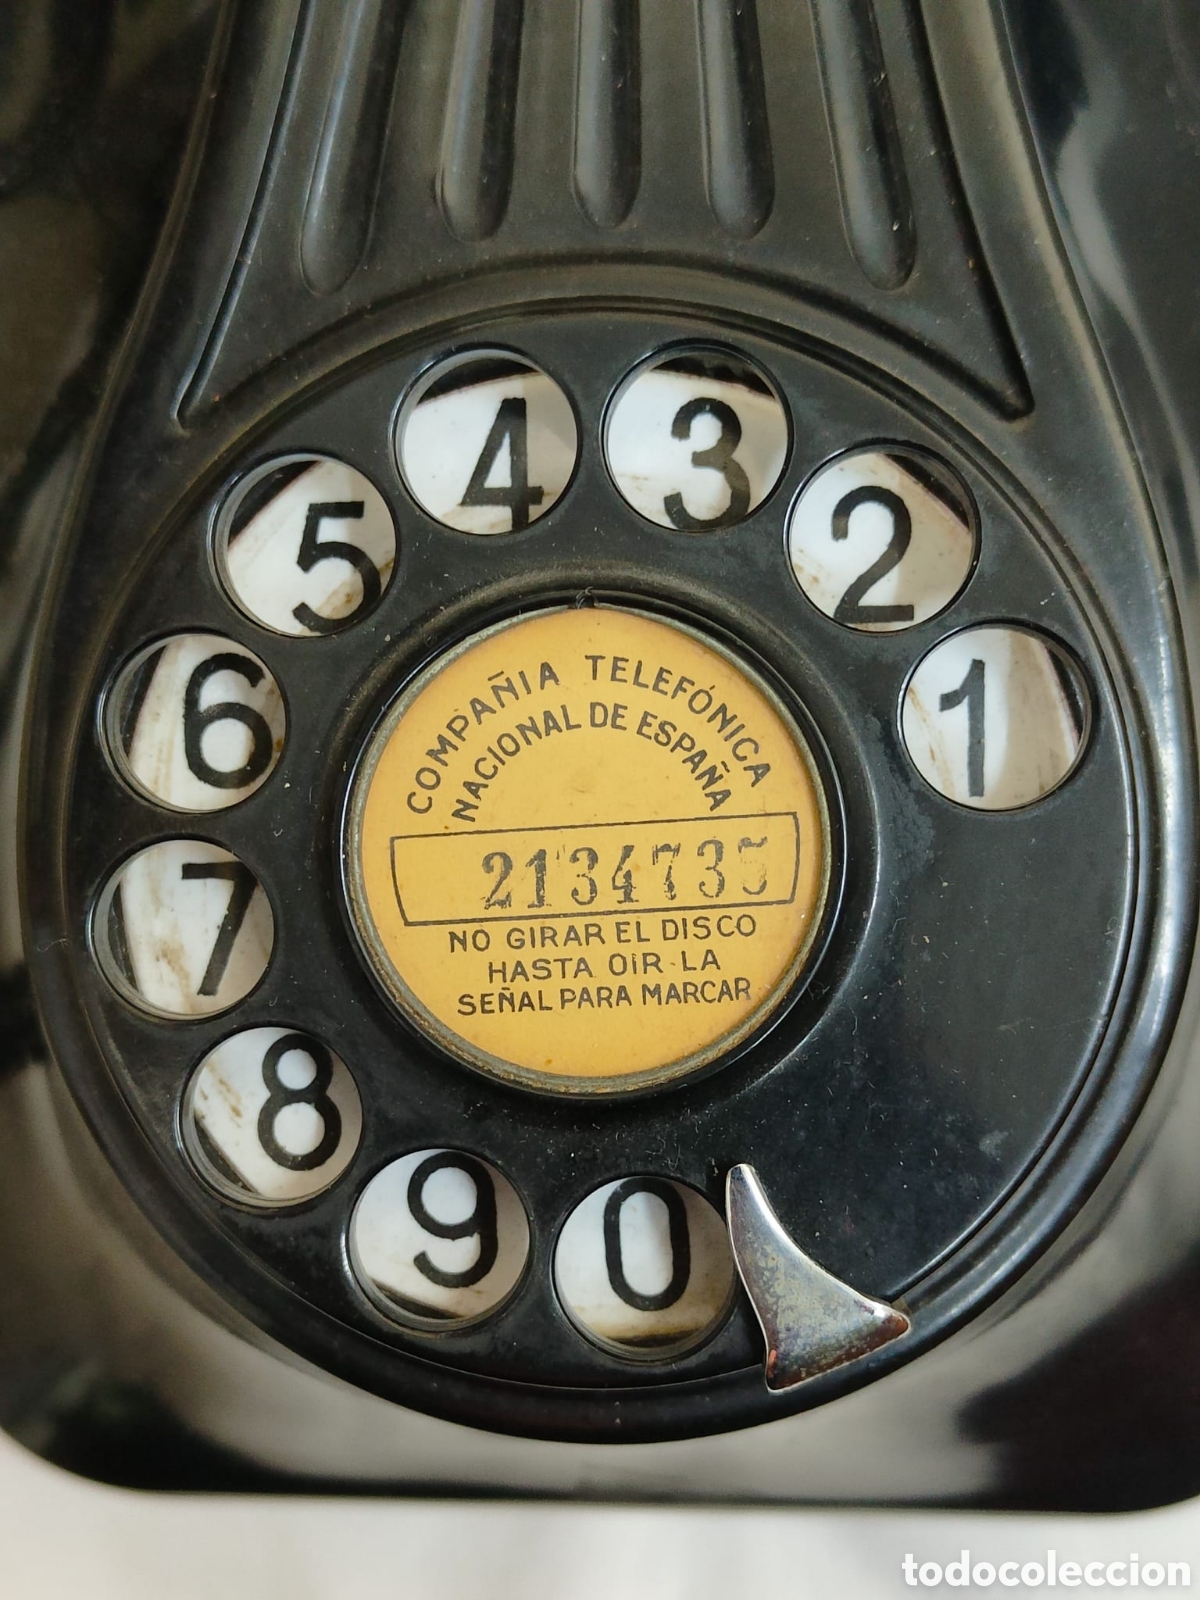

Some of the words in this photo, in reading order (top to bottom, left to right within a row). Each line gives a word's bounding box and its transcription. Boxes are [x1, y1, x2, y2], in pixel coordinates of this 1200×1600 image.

[459, 397, 545, 531] 4
[663, 397, 751, 531] 3
[292, 501, 383, 635] 5
[832, 485, 915, 622] 2
[183, 653, 273, 790] 6
[406, 661, 560, 815] COMPAÑIA
[585, 654, 771, 788] TELEFÓNICA
[451, 704, 581, 822] NACIONAL
[589, 702, 628, 731] DE
[636, 711, 732, 811] ESPAÑA
[939, 658, 986, 798] 1
[181, 861, 261, 995] 7
[449, 929, 491, 953] NO
[506, 922, 606, 950] GIRAR
[616, 920, 651, 944] EL
[661, 914, 757, 941] DISCO
[481, 835, 769, 910] 2134735
[457, 986, 553, 1016] SEÑAL
[560, 985, 633, 1010] PARA
[641, 977, 752, 1005] MARCAR
[488, 956, 594, 984] HASTA
[681, 949, 721, 972] LA
[257, 1033, 342, 1171] 8
[407, 1151, 498, 1288] 9
[604, 1176, 691, 1311] 0
